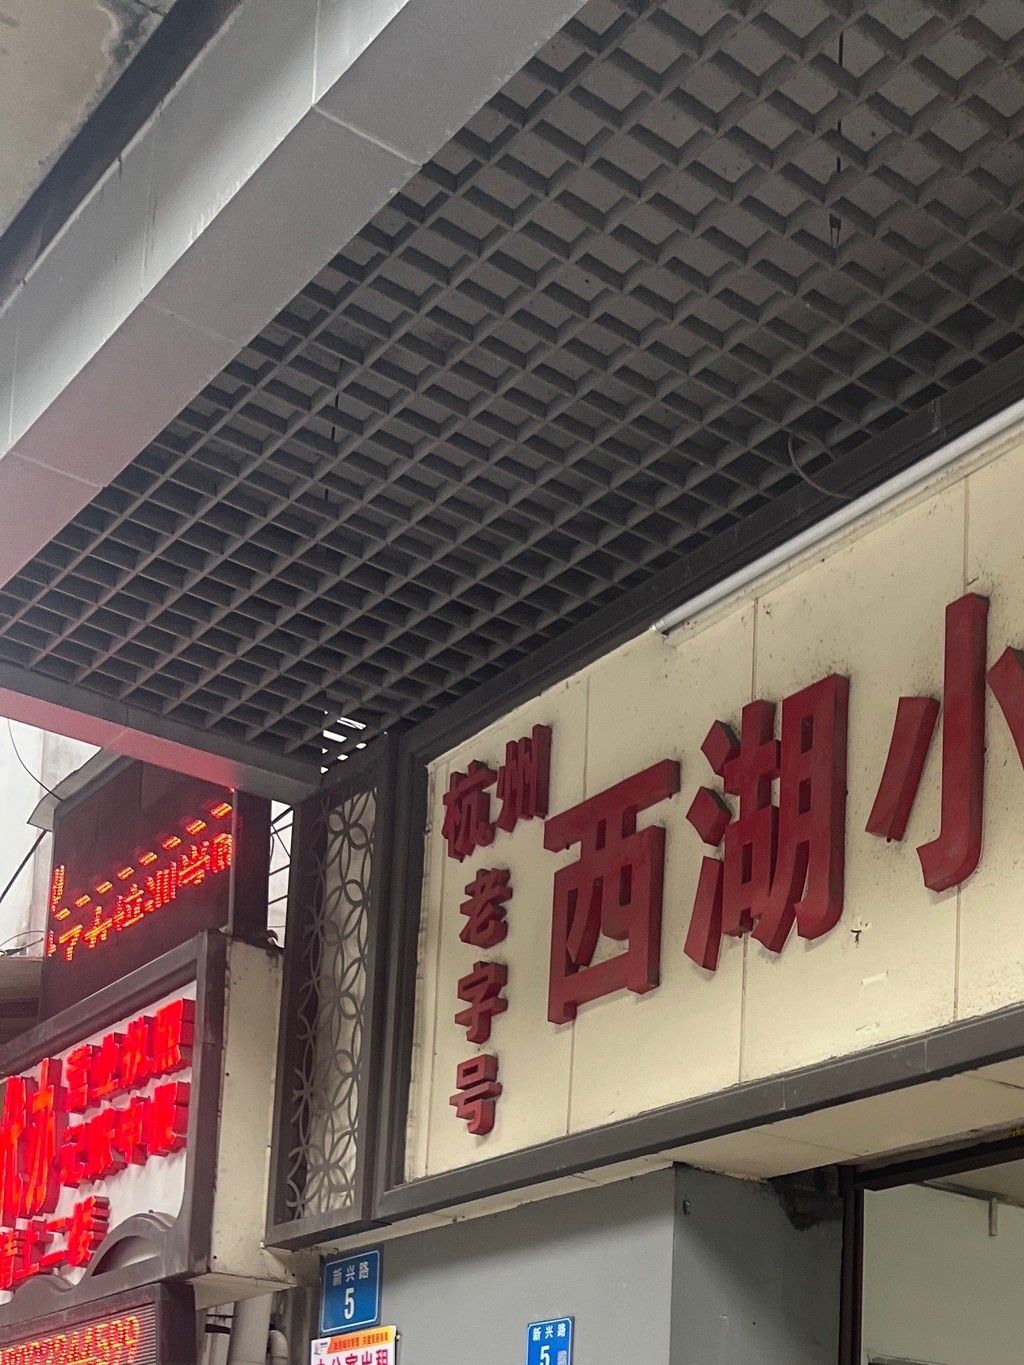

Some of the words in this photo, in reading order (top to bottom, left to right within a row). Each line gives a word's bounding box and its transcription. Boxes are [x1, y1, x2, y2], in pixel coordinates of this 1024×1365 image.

[442, 723, 552, 861] 杭州
[449, 868, 513, 1136] 老字号
[332, 1261, 369, 1286] 新兴路
[343, 1287, 355, 1320] 5
[533, 1322, 566, 1341] 新兴路
